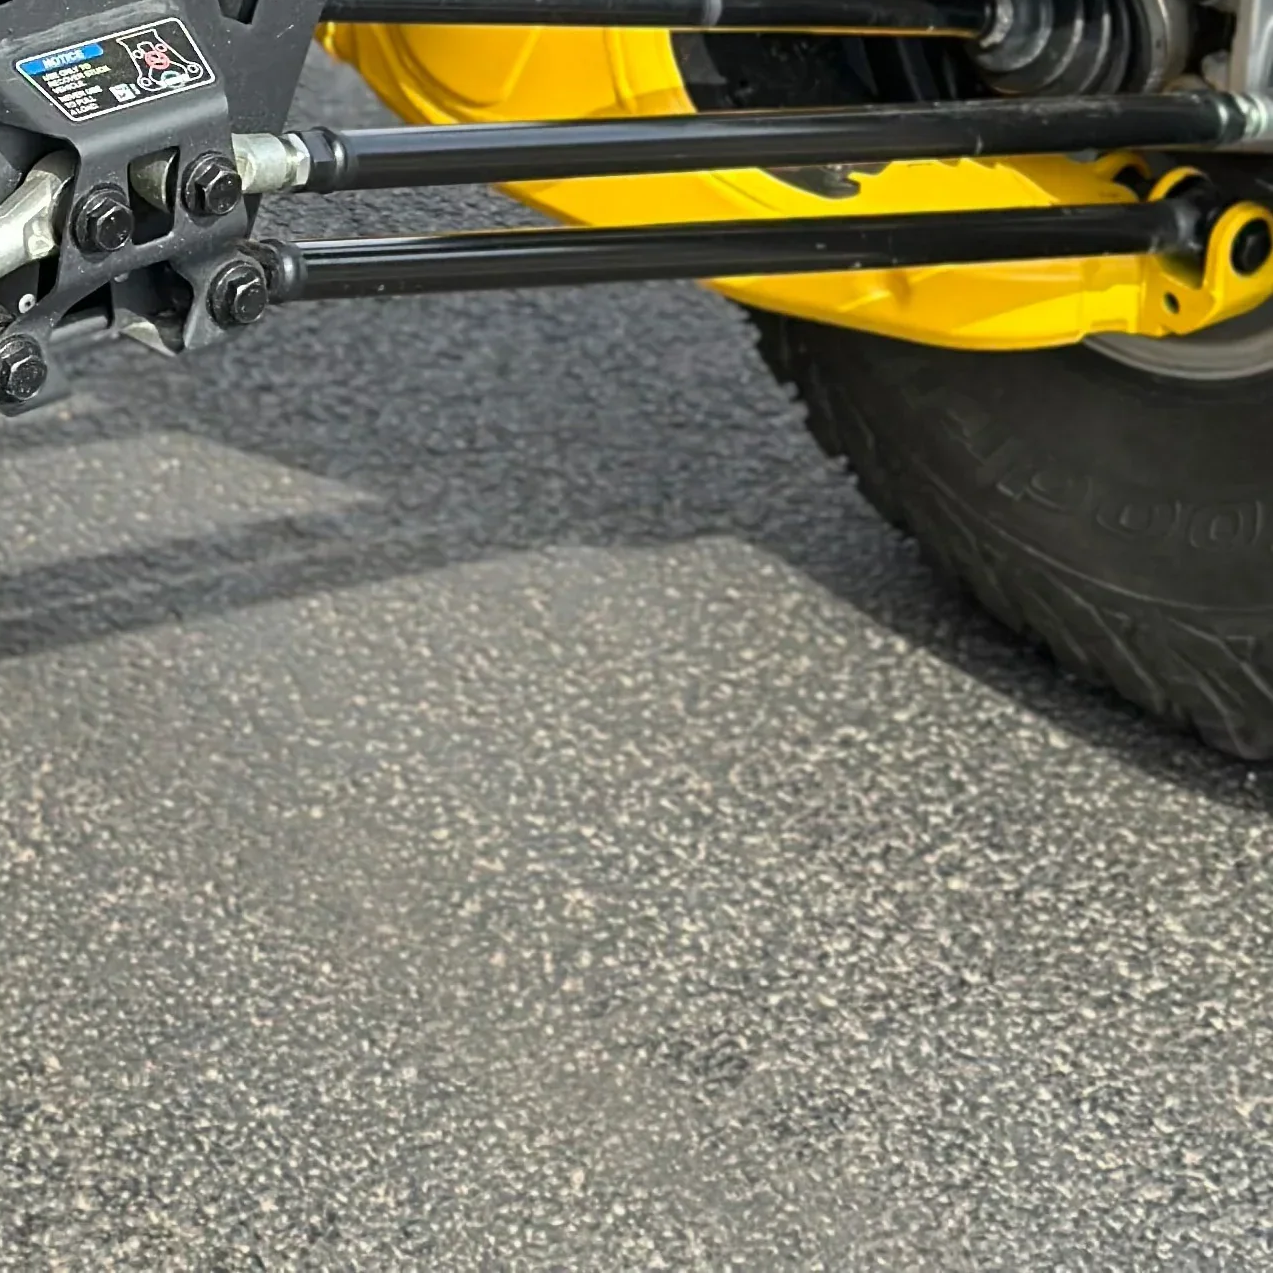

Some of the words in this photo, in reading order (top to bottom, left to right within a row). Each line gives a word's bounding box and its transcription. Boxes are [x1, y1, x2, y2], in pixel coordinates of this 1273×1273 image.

[42, 49, 85, 71] NOTICE
[58, 65, 79, 76] ONLY
[78, 63, 92, 71] TO
[47, 72, 85, 88] RECOVER
